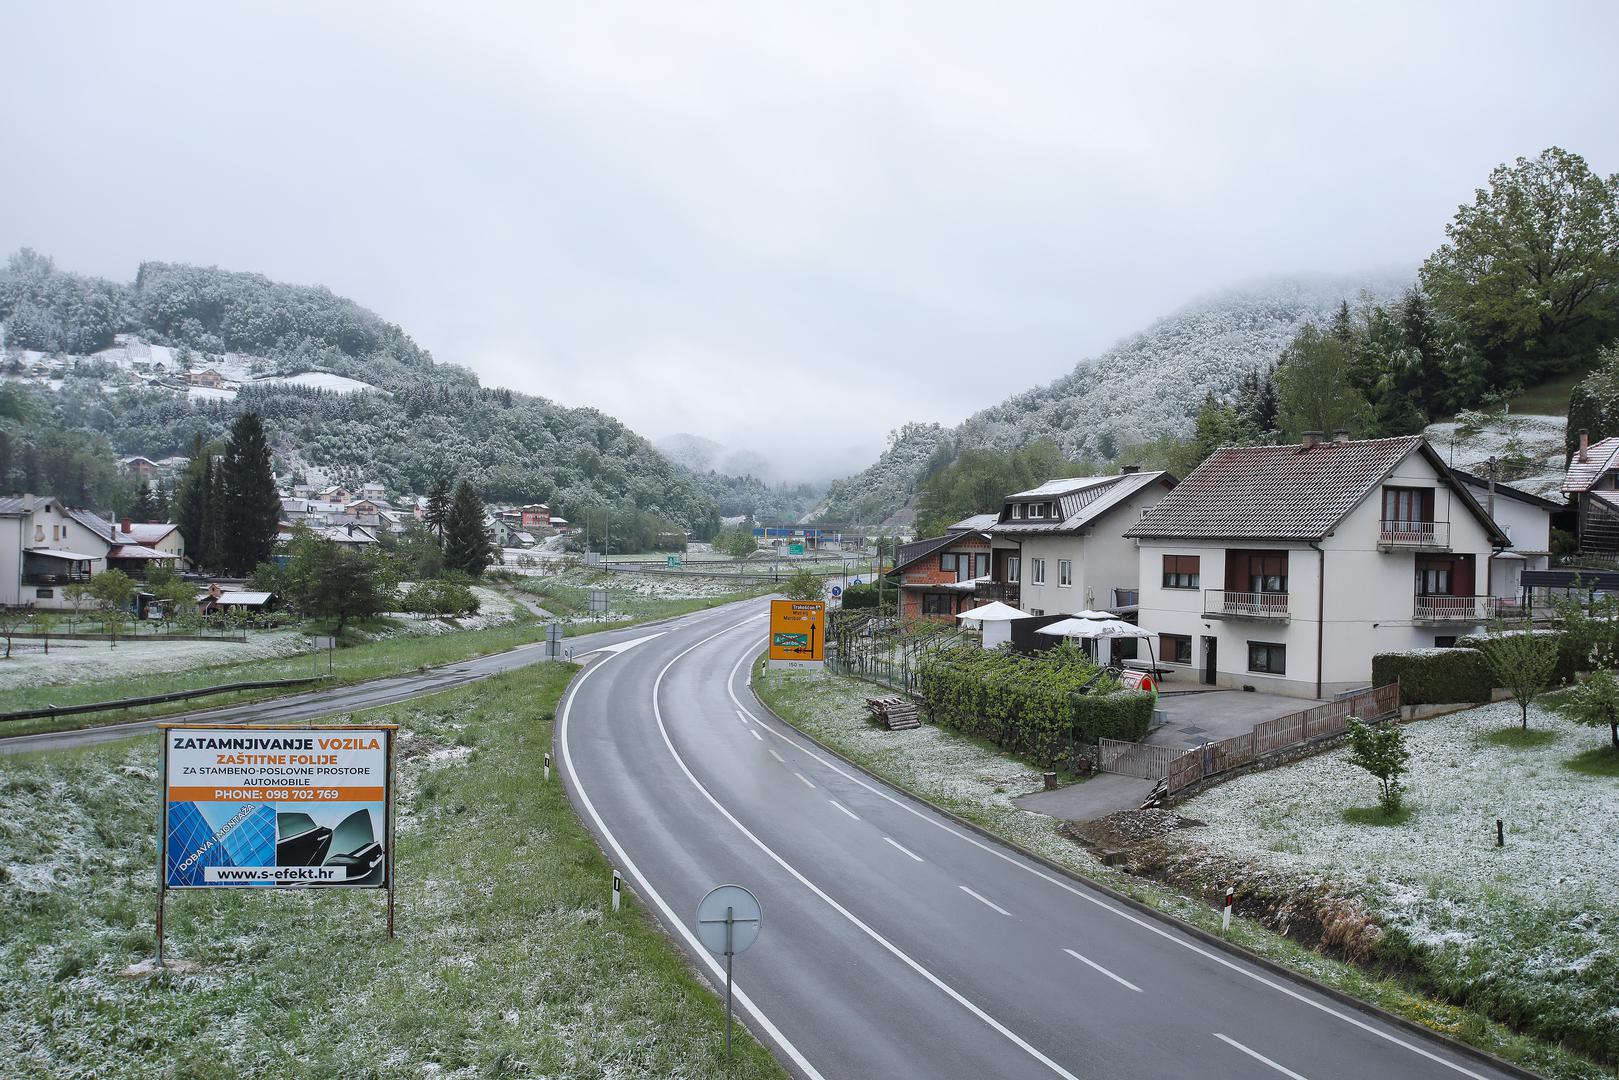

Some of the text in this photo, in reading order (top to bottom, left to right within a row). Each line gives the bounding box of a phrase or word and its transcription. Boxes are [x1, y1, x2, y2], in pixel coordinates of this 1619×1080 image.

[174, 738, 380, 750] ZATAMNJIVANJE VOZILA
[217, 752, 337, 765] ZAŠTITNE FOLIJE
[200, 767, 314, 775] STAMBENO-POSLOVNE
[317, 767, 370, 775] PROSTORE
[244, 778, 310, 786] AUTOMOBILE
[215, 790, 339, 799] PHONE: 098 702 769
[180, 840, 214, 871] DOBAVA
[216, 804, 256, 839] MONTAŽA
[218, 868, 334, 879] www.s-efekt.hr
